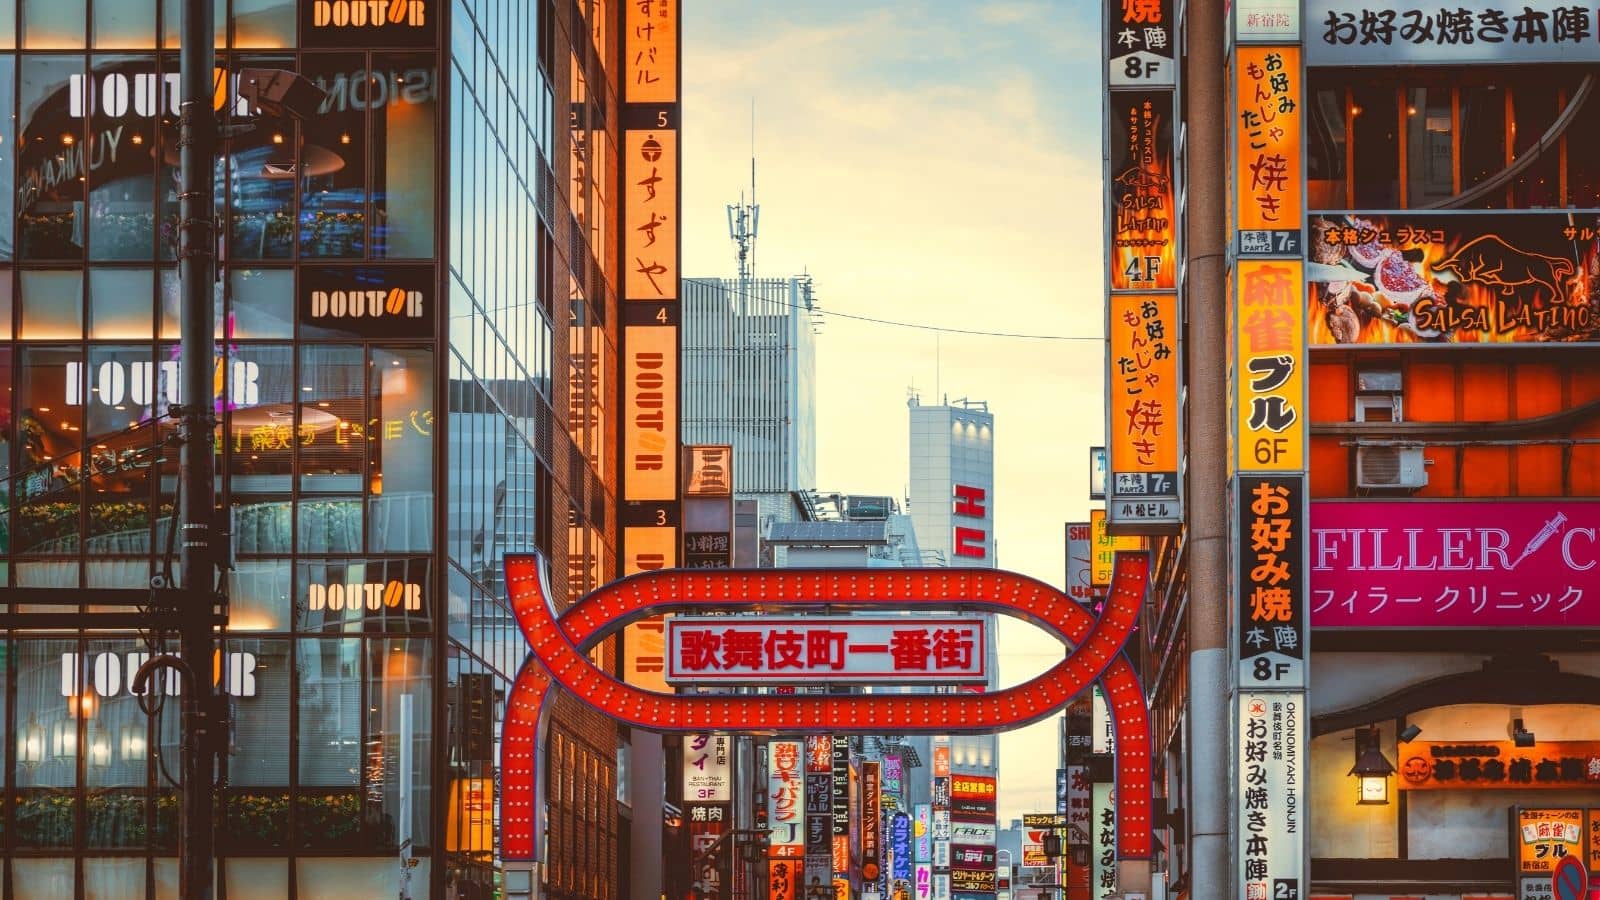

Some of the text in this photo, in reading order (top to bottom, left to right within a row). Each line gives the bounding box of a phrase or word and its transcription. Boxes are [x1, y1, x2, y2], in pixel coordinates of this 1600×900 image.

[314, 0, 425, 27] DOUTOR
[1323, 7, 1590, 46] お好み焼き本陣
[1117, 27, 1167, 49] 本陣
[1124, 56, 1160, 79] 8F
[1265, 53, 1296, 114] お好み
[1247, 62, 1285, 142] もんじゃ
[657, 112, 668, 127] 5
[1241, 109, 1267, 150] たこ
[1249, 153, 1288, 222] 焼き
[636, 168, 668, 296] すずや
[1244, 242, 1271, 251] PART2
[1275, 231, 1297, 251] 7F
[1325, 228, 1445, 245] 本格シュラスコ
[1562, 227, 1600, 241] サル
[1124, 255, 1162, 282] 4F
[312, 287, 423, 318] DOUTOR
[655, 307, 667, 323] 4
[1243, 264, 1295, 353] 麻雀
[1414, 299, 1589, 332] SALSA LATINO
[1140, 300, 1171, 361] お好み
[1123, 309, 1160, 388] もんじゃ
[1118, 356, 1143, 395] たこ
[1246, 354, 1296, 433] ブル
[635, 353, 666, 471] DOUTOR
[1125, 399, 1163, 466] 焼き
[1254, 437, 1289, 464] 6F
[1119, 484, 1145, 493] PART2
[1151, 473, 1171, 493] 7F
[655, 510, 667, 525] 3
[1122, 503, 1169, 517] 小松ビル
[1250, 481, 1293, 623] お好み焼
[1312, 527, 1597, 571] FILLER C
[309, 580, 421, 611] DOUTOR
[1312, 585, 1584, 614] フィラー クリニック
[680, 628, 975, 671] 歌舞伎町一番街
[1245, 626, 1298, 650] 本陣
[1252, 656, 1291, 681] 8F
[1286, 702, 1297, 834] OKONOMIYAKI HONJIN
[697, 789, 716, 799] 3F
[1244, 717, 1269, 882] お好み焼き本陣
[691, 806, 723, 822] 焼肉
[895, 815, 909, 869] カラオケ
[1538, 823, 1564, 837] 麻雀
[776, 846, 795, 857] 4F
[1100, 808, 1116, 900] お好み焼
[1535, 843, 1569, 858] ブル
[1275, 882, 1297, 899] 2F
